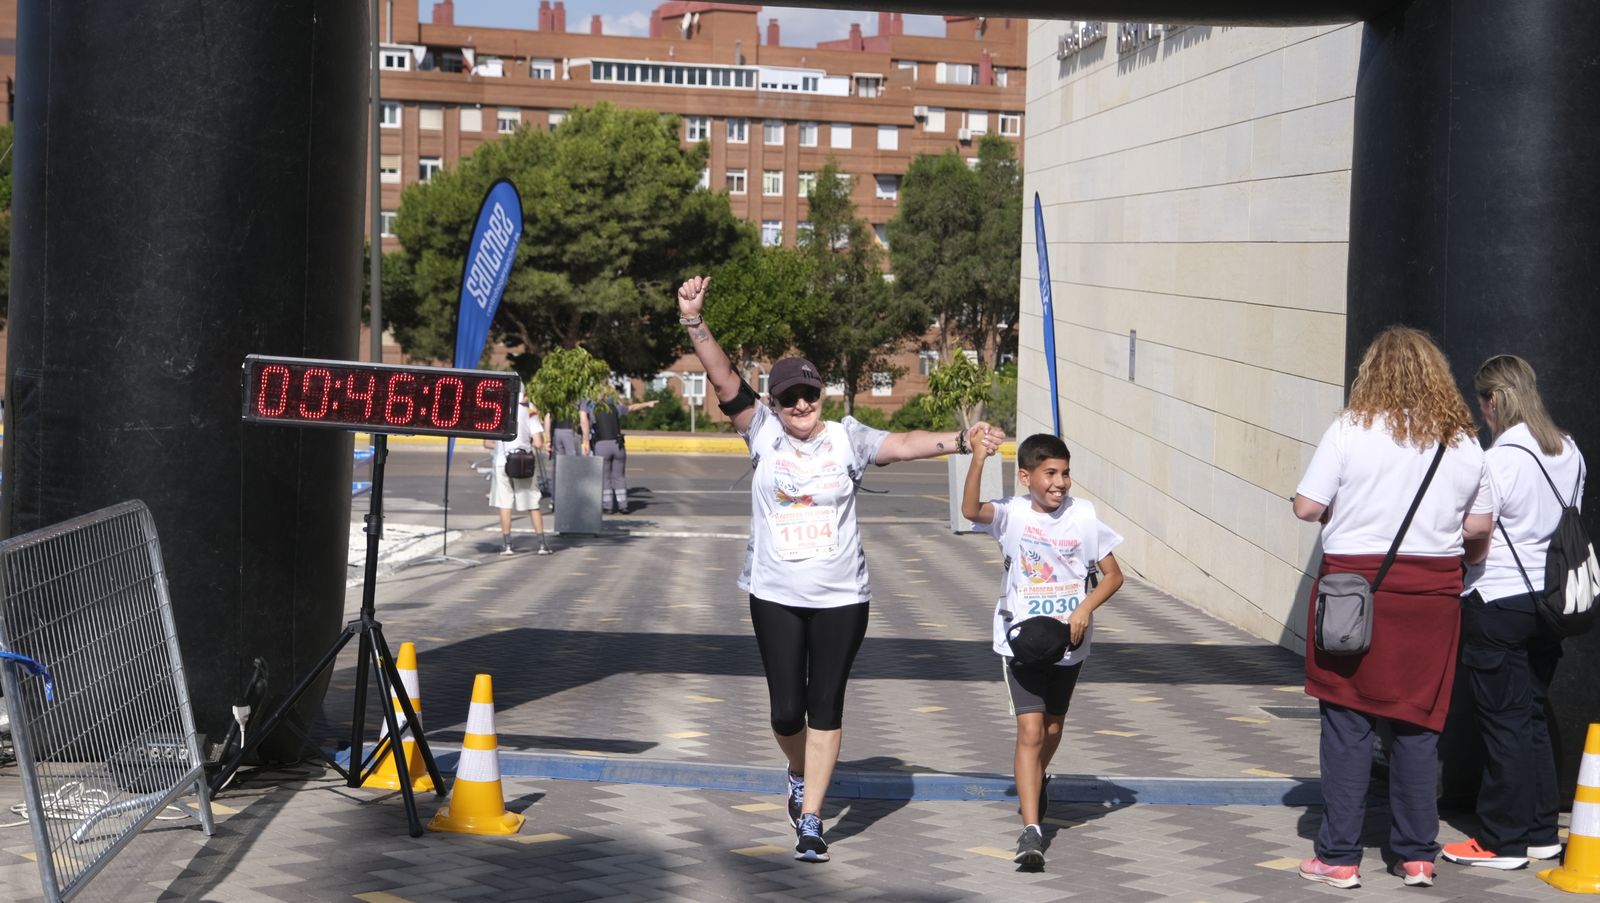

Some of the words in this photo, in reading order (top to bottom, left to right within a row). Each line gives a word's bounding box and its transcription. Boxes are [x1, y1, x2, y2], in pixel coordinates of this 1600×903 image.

[257, 365, 503, 431] 00:46:05
[780, 522, 833, 542] 1104
[1028, 596, 1080, 615] 2030
